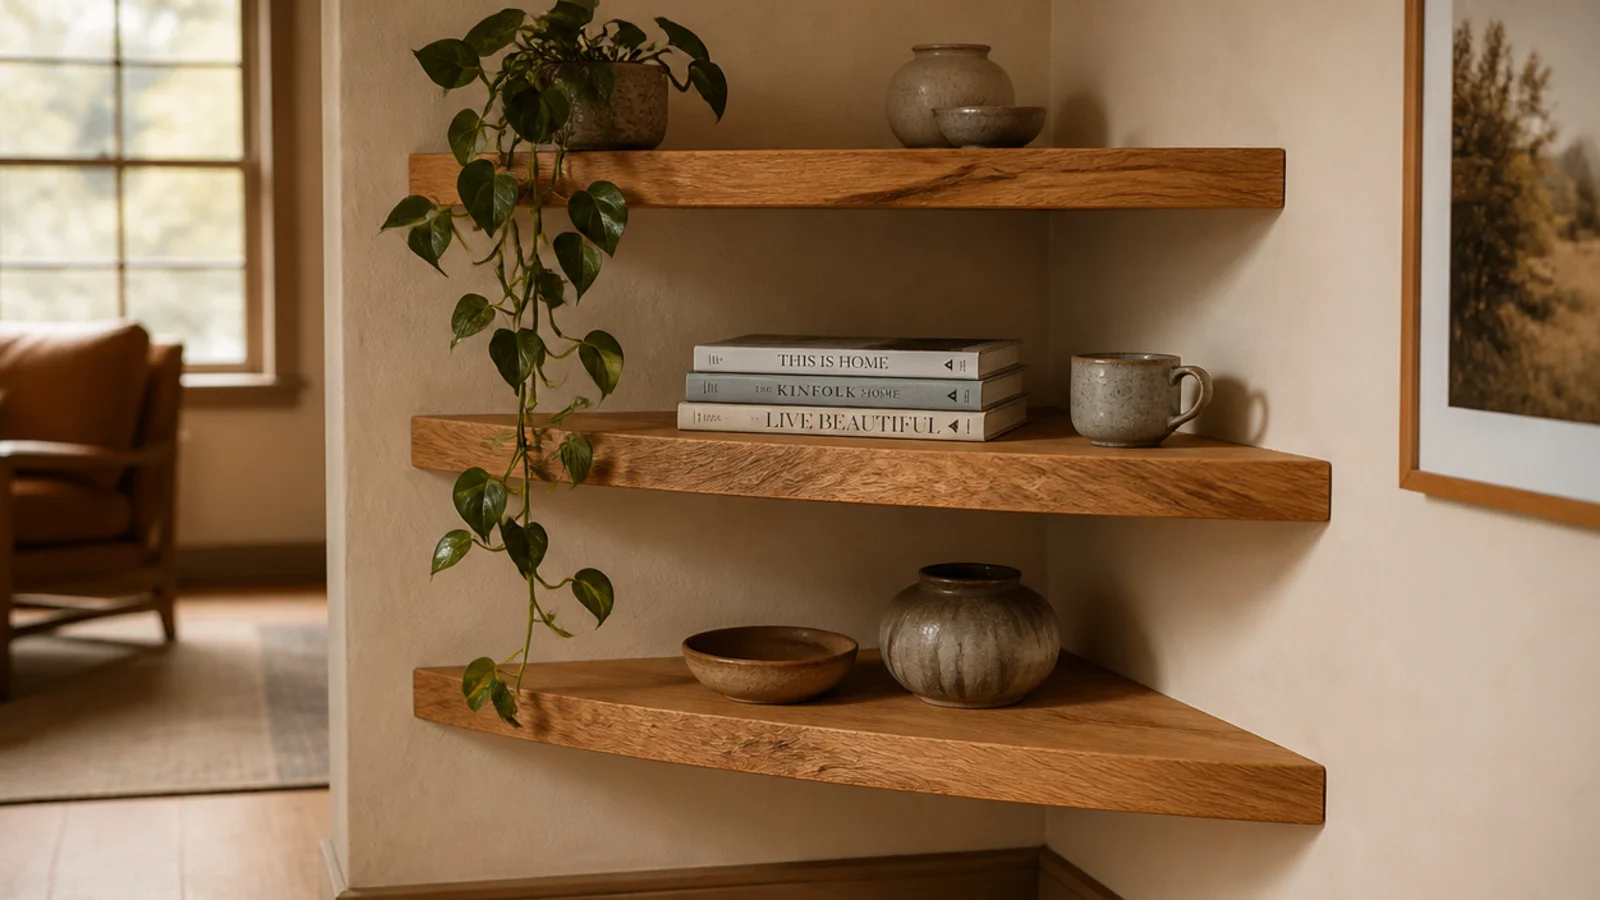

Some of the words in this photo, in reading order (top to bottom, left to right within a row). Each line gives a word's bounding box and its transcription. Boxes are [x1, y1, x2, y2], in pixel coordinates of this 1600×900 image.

[777, 353, 816, 368] THIS
[821, 355, 834, 368] IS
[839, 356, 888, 370] HOME
[777, 384, 856, 398] KINFOLK
[766, 412, 813, 429] LIVE
[819, 412, 940, 434] BEAUTIFUL
